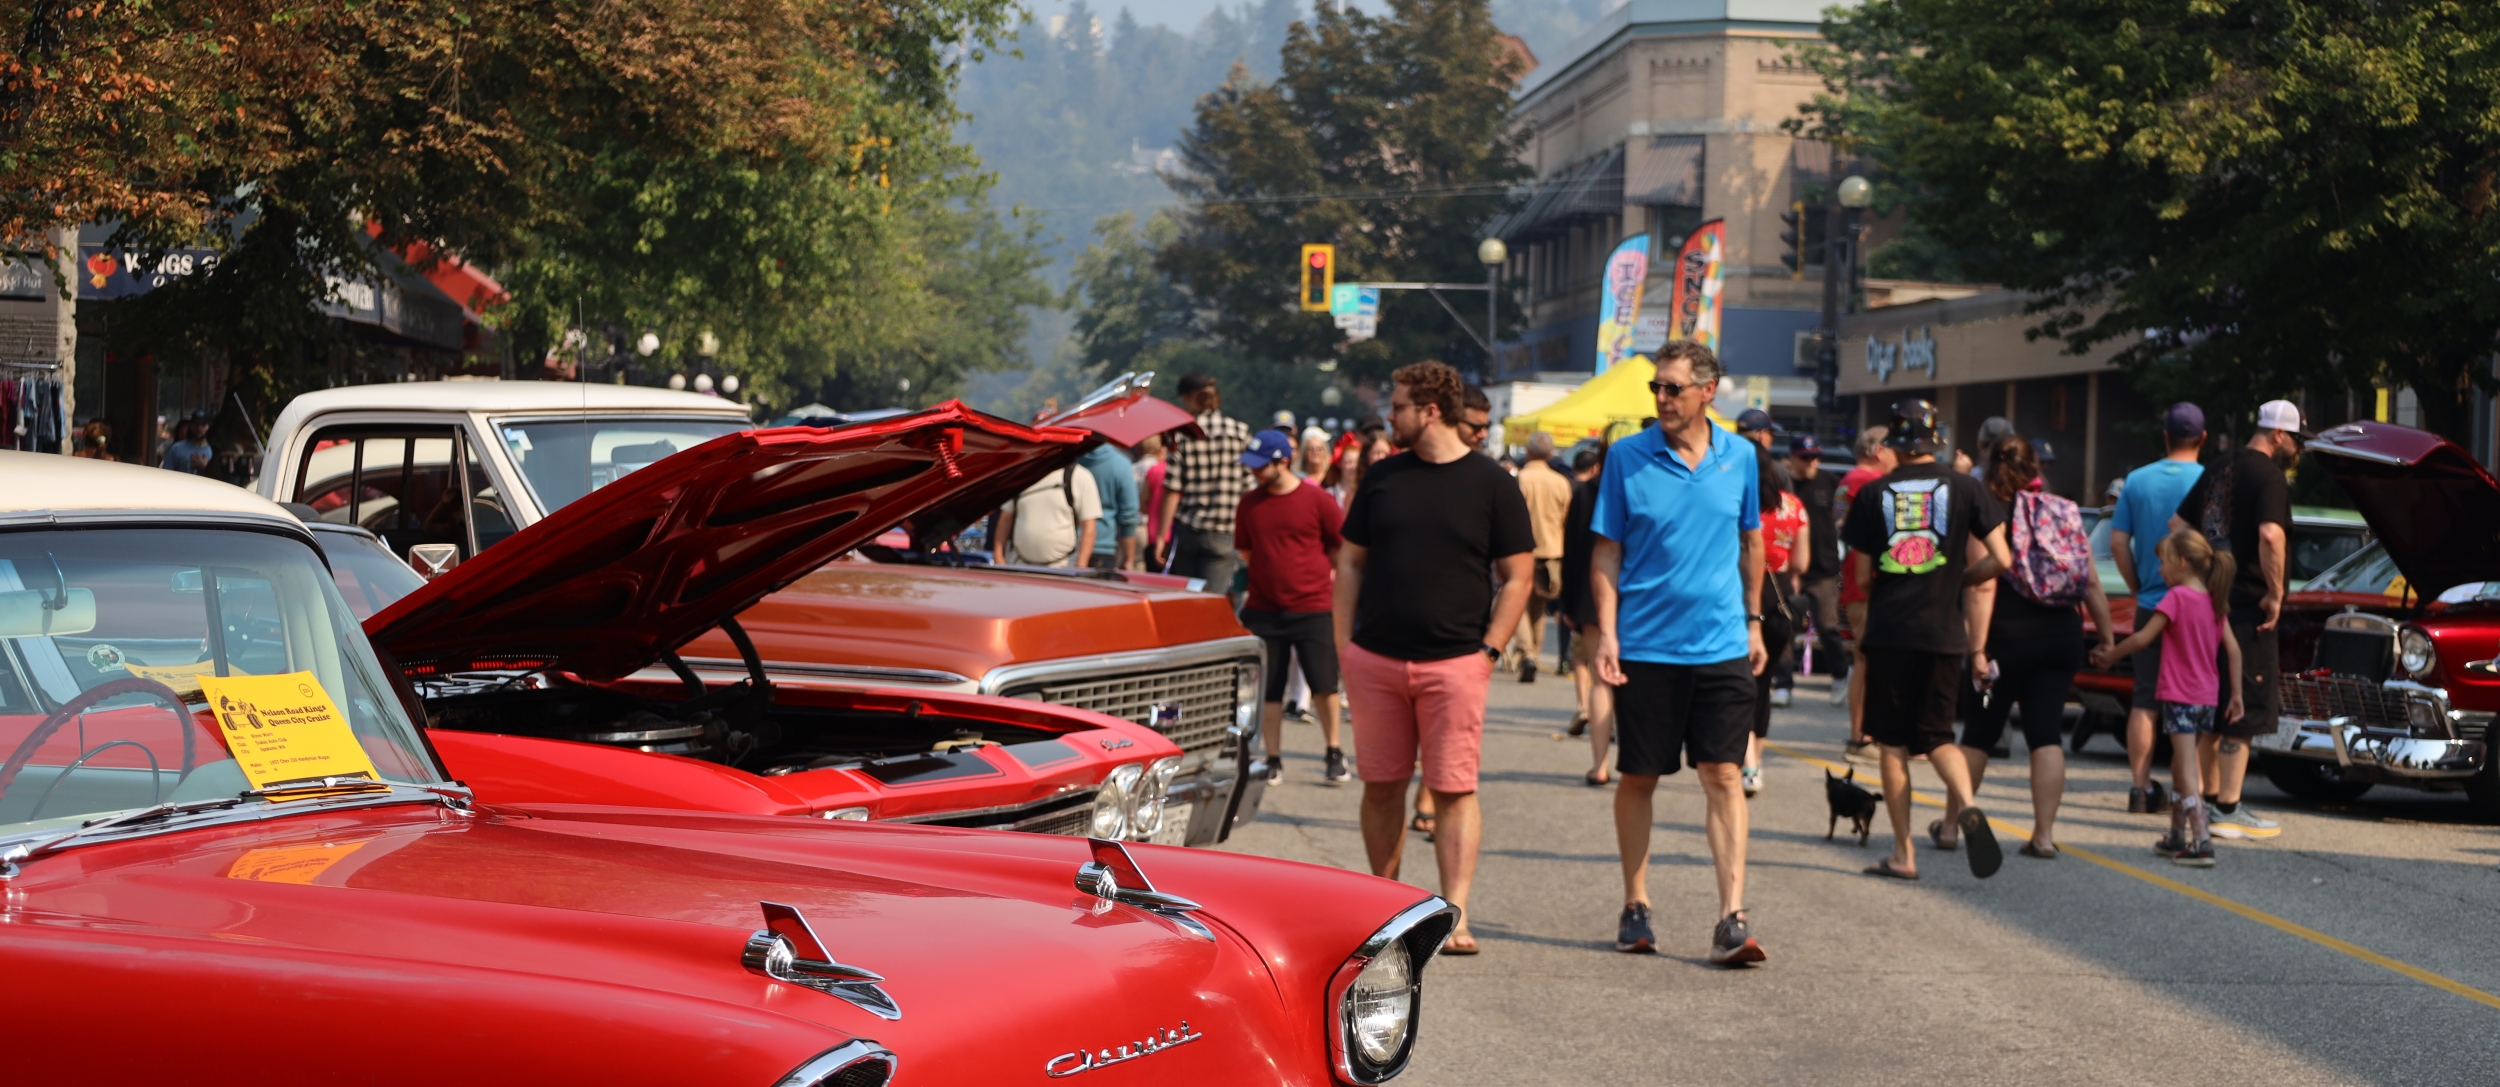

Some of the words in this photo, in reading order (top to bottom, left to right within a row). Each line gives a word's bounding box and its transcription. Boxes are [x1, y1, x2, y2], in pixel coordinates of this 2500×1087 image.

[22, 275, 43, 289] Hut
[1615, 262, 1636, 326] ICE
[260, 709, 286, 717] Nelson
[284, 706, 305, 715] Road
[302, 705, 327, 713] Kings
[268, 718, 292, 727] Queen
[290, 716, 307, 725] City
[306, 714, 331, 723] Cruise
